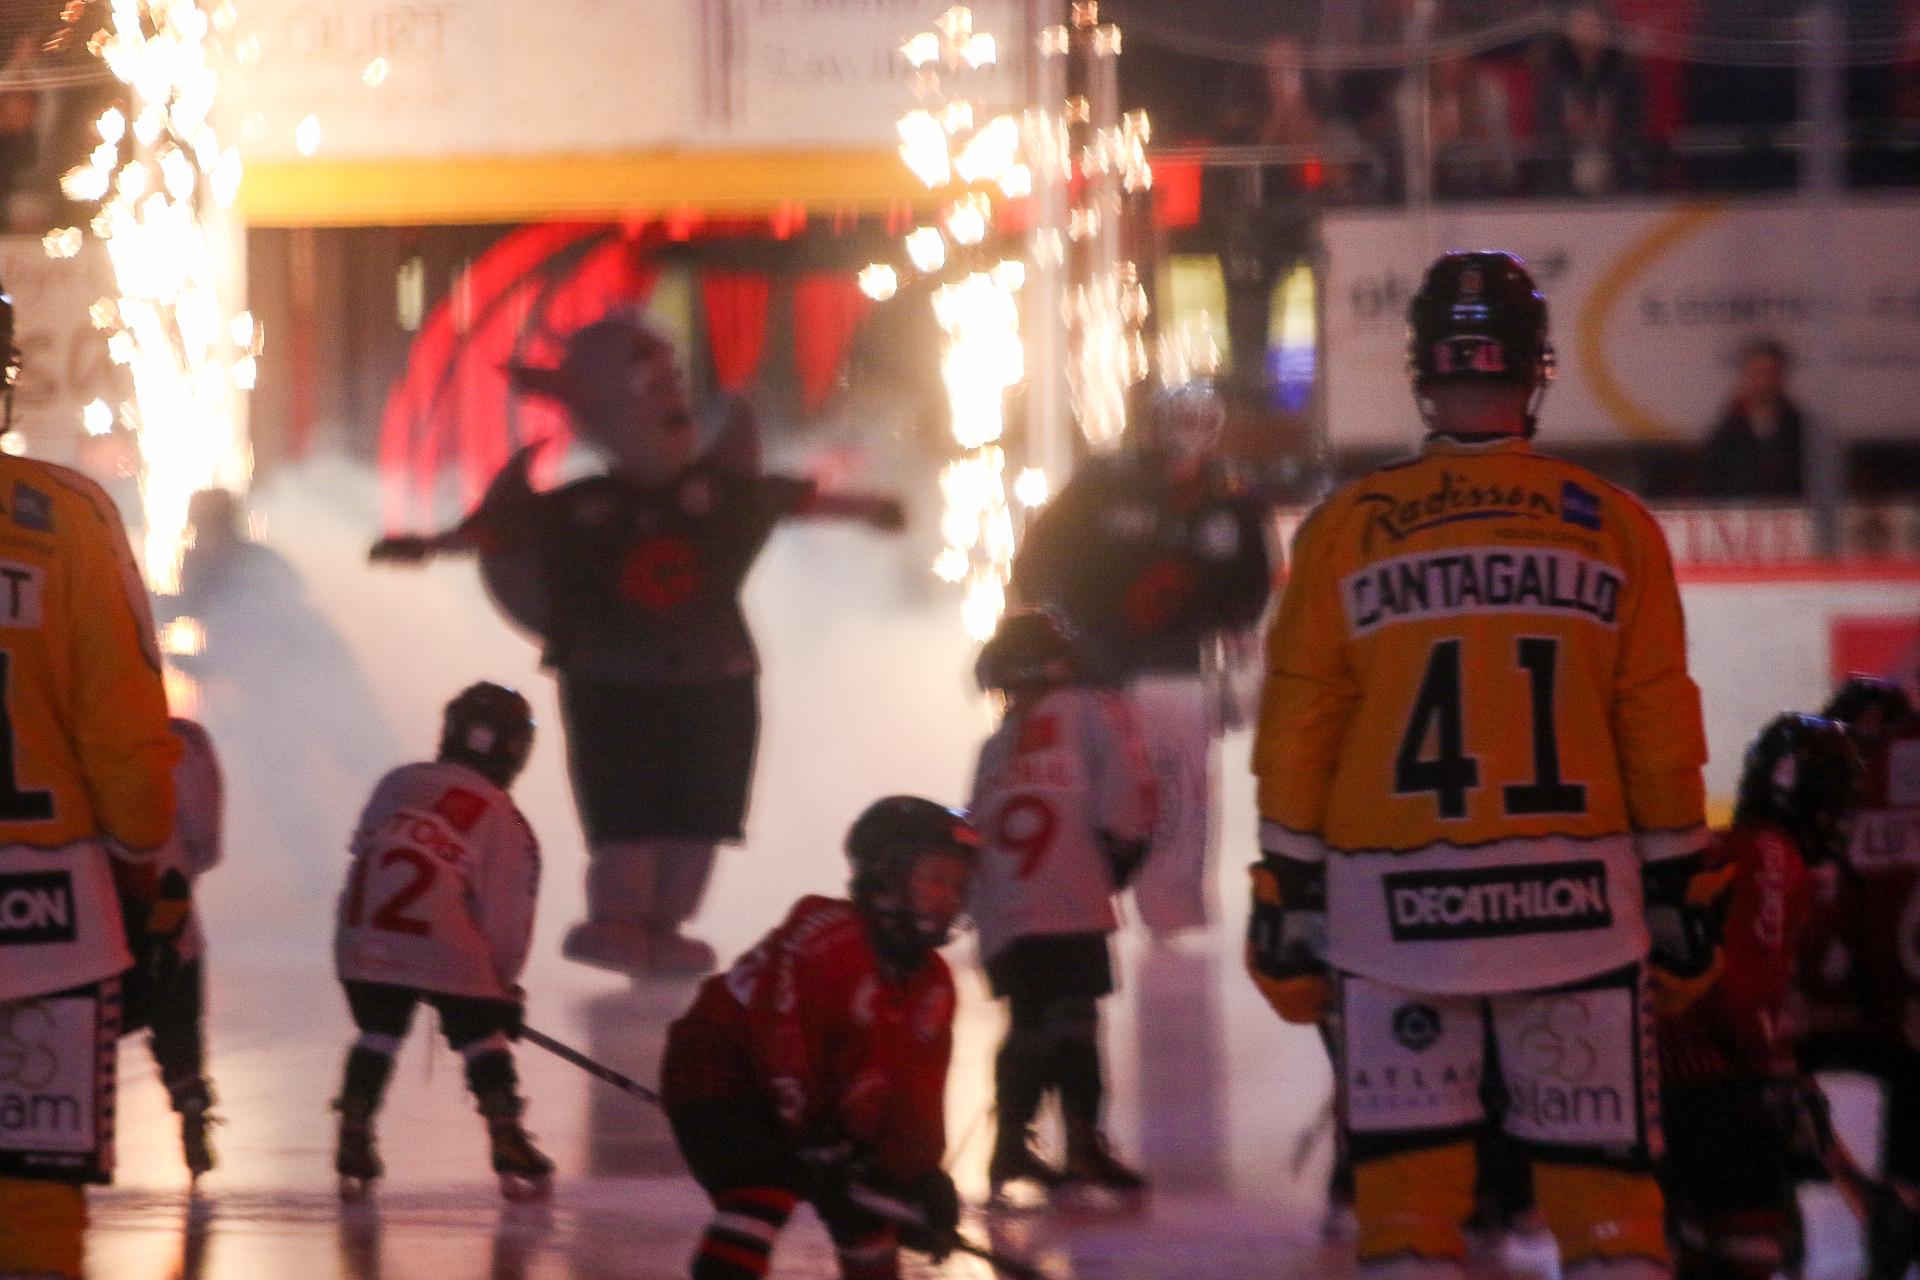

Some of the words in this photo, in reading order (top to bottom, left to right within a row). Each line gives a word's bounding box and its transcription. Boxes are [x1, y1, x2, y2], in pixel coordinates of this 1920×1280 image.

[1356, 470, 1556, 552] Radisson
[1353, 554, 1623, 627] CANTAGALLO
[1395, 637, 1585, 818] 41
[1000, 794, 1057, 879] 9
[0, 887, 67, 929] ON
[1393, 874, 1608, 928] DECATHLON
